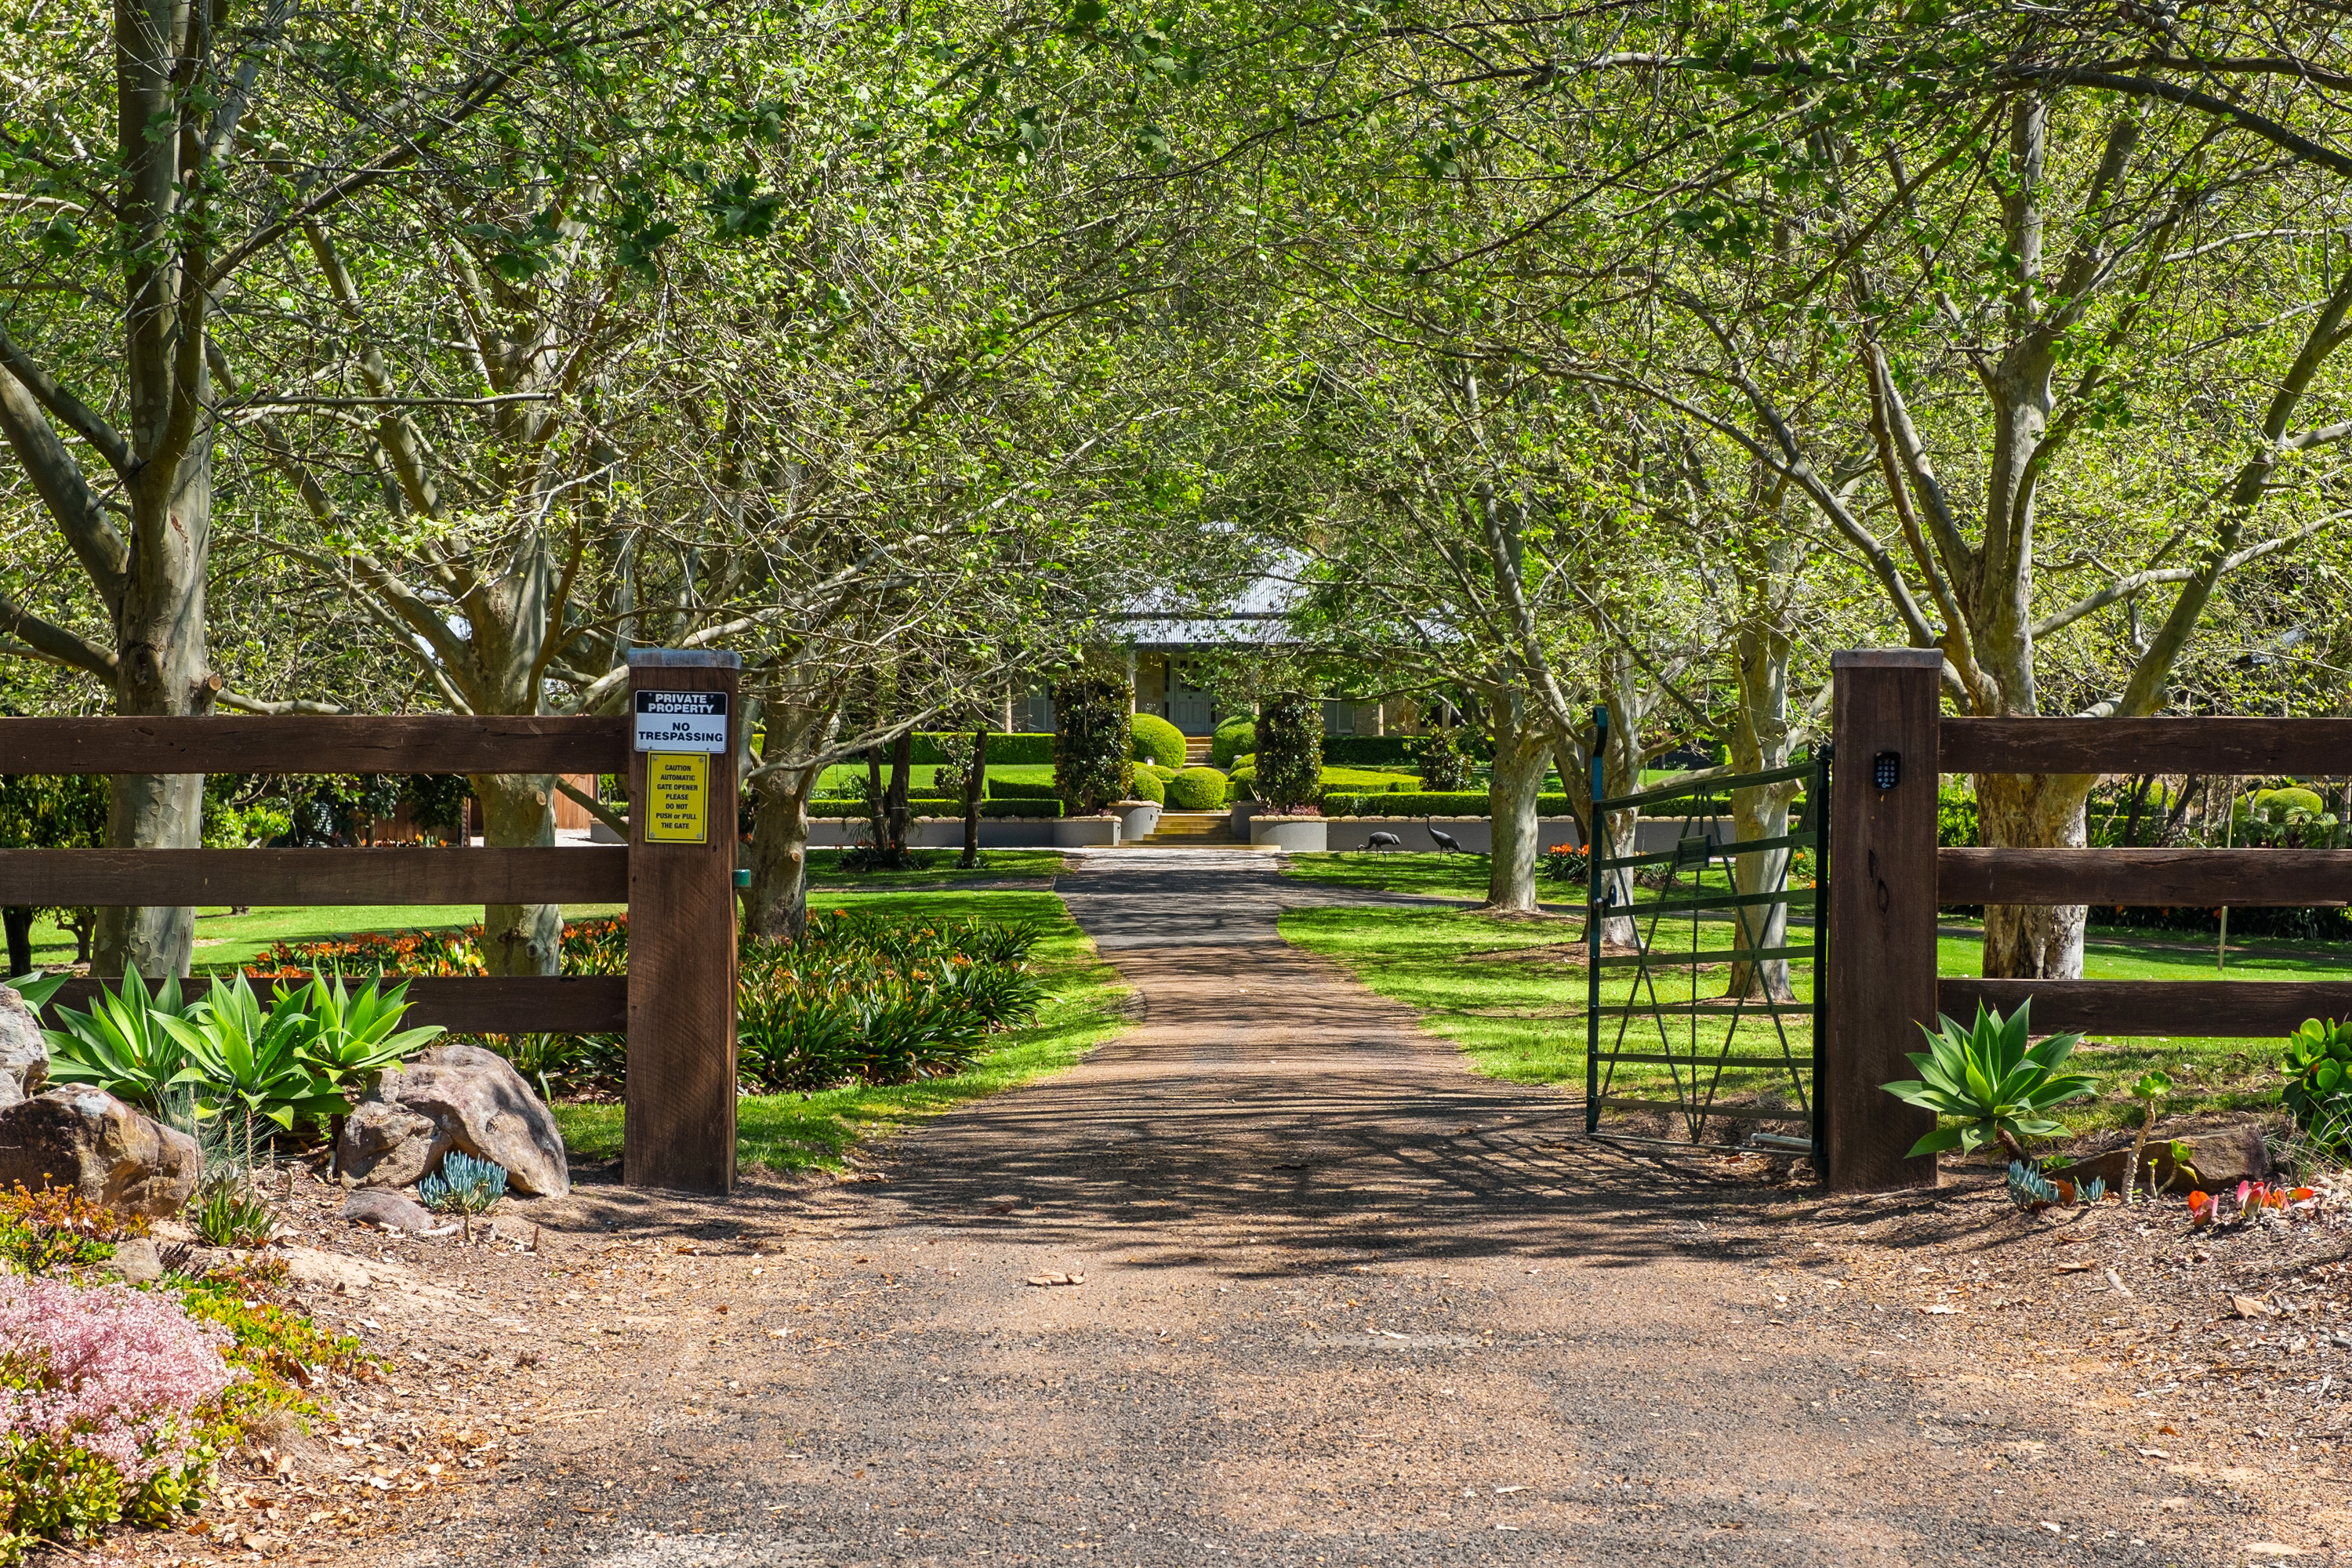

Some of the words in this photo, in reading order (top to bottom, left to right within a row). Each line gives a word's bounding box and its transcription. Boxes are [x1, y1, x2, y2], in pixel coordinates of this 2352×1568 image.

[655, 694, 706, 703] PRIVATE
[648, 703, 714, 713] PROPERTY
[672, 722, 690, 731] NO
[638, 731, 723, 742] TRESPASSING
